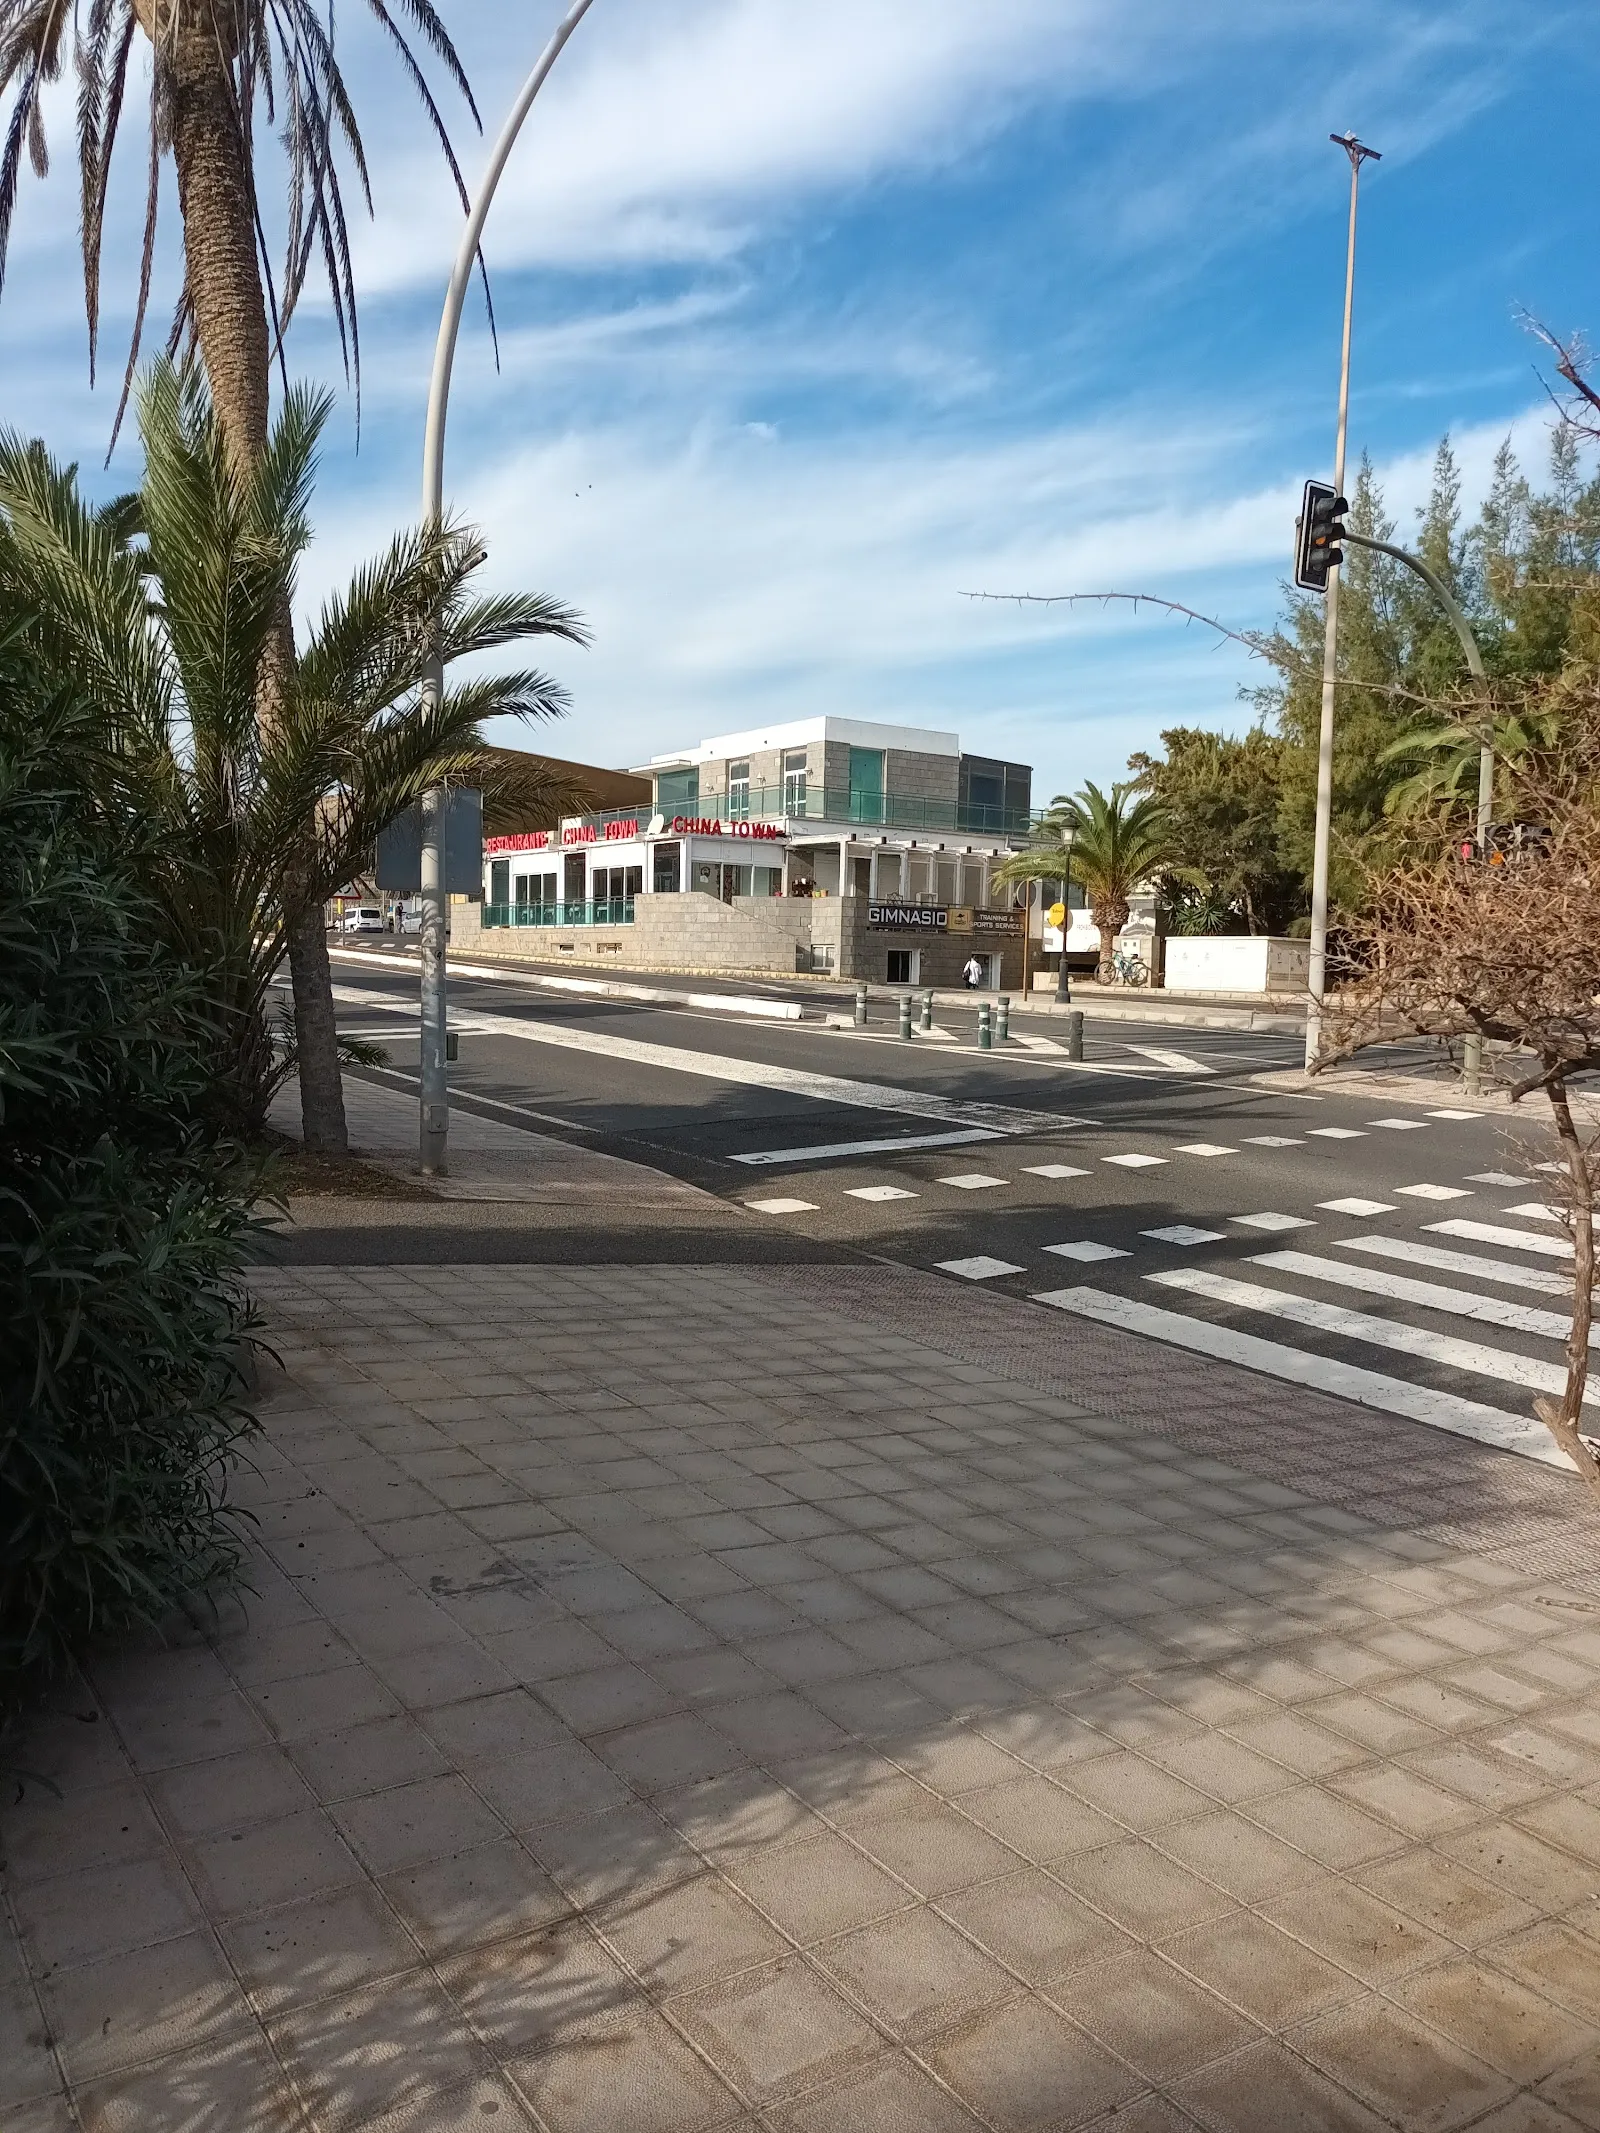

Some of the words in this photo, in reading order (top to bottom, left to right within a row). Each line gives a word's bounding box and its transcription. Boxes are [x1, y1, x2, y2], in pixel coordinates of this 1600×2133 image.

[487, 831, 548, 853] RESTAURANTE
[564, 825, 596, 844] CHINA
[603, 819, 638, 840] TOWN
[673, 815, 722, 836] CHINA
[730, 821, 776, 841] TOWN
[868, 907, 947, 926] GIMNASIO
[979, 914, 1008, 922] TRAINING
[995, 922, 1024, 930] SERVICES
